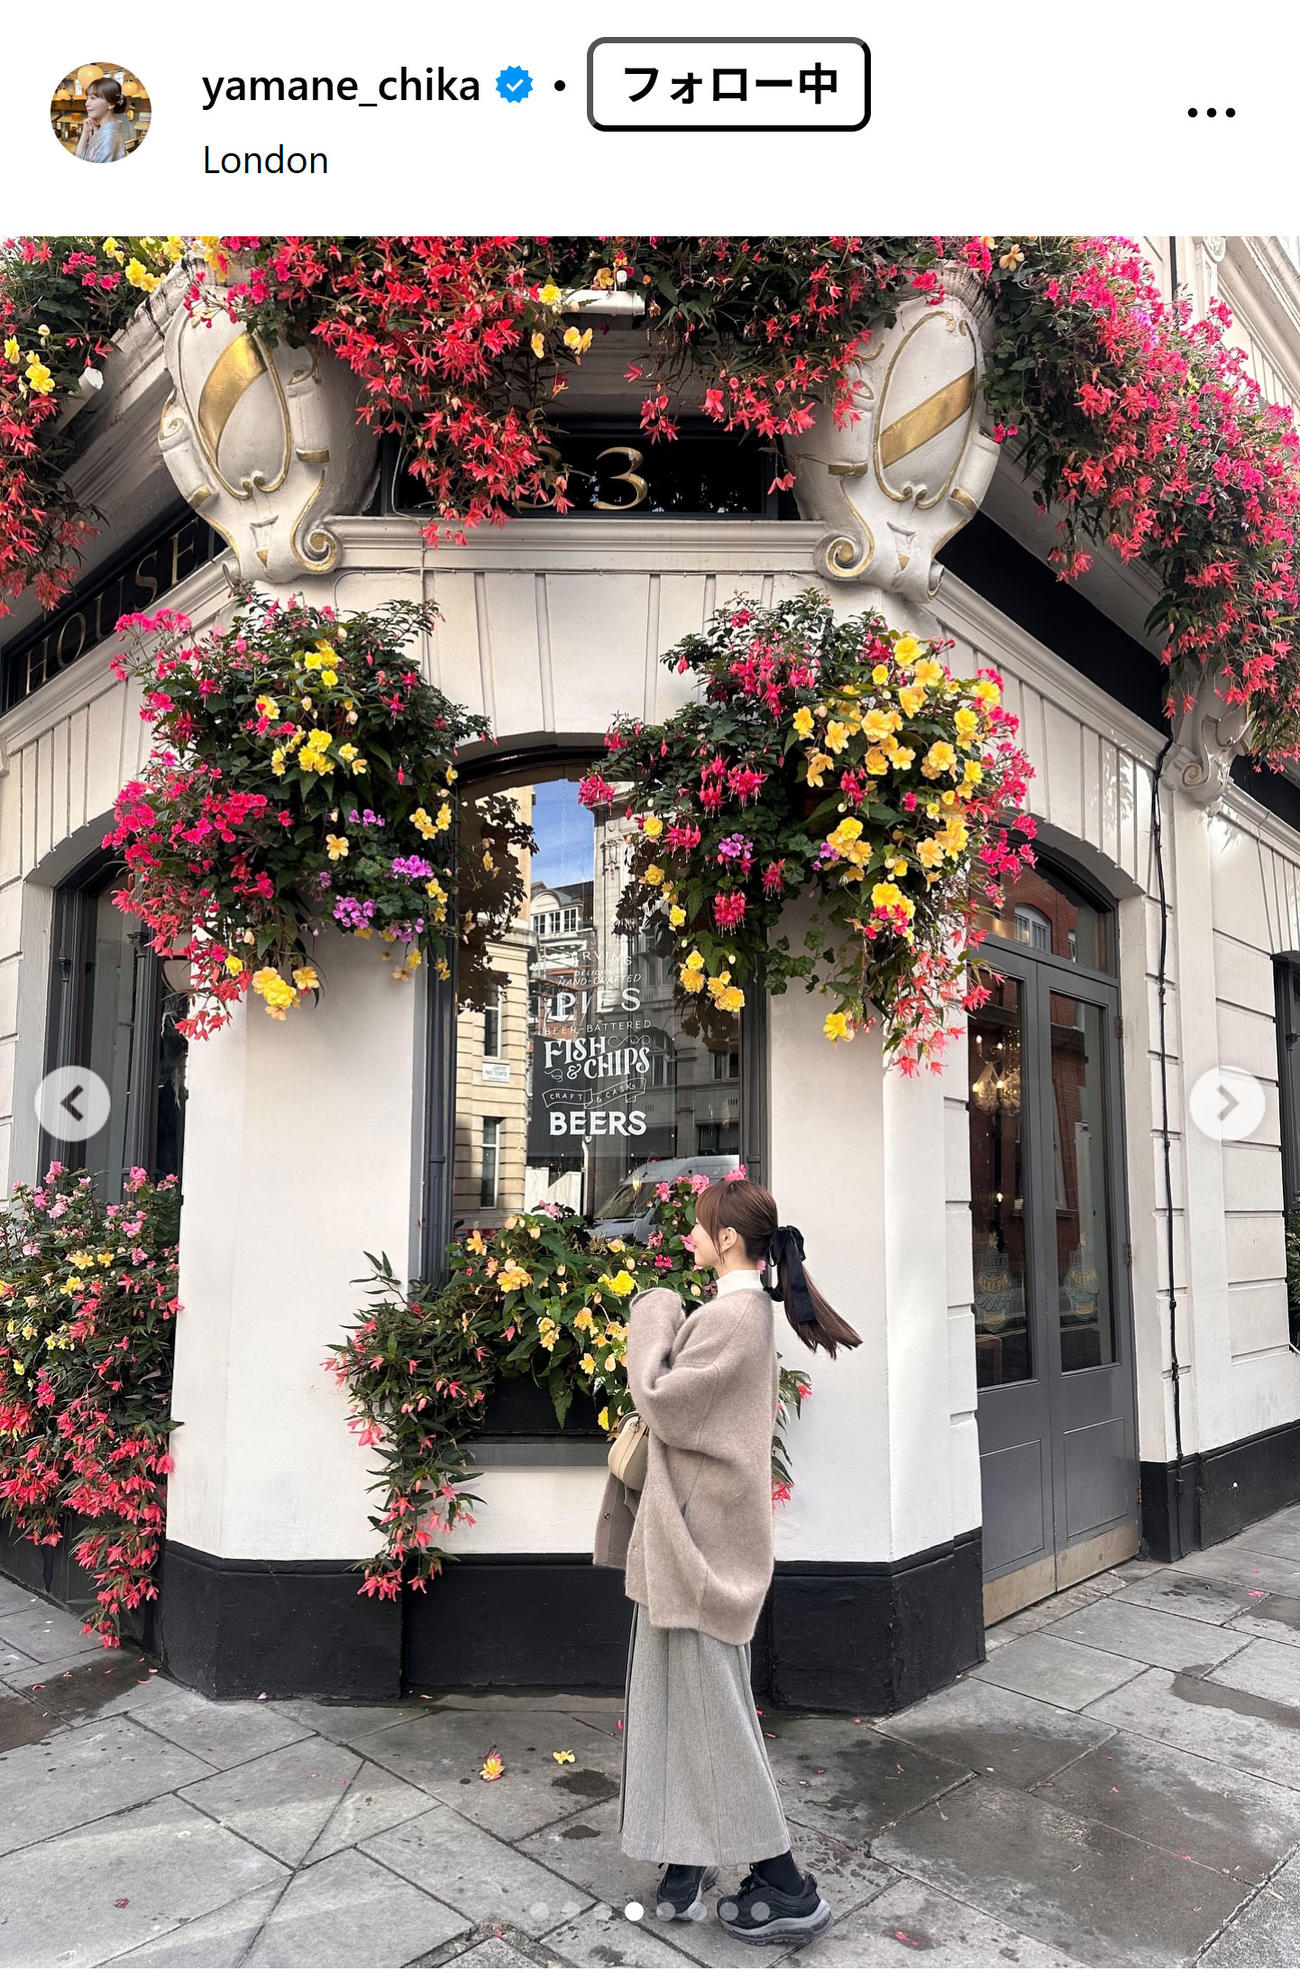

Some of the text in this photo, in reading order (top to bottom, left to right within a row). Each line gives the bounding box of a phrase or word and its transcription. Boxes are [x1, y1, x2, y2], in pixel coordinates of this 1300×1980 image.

[26, 516, 200, 697] HOUSE
[557, 973, 642, 987] HAND-CRAFTED
[556, 987, 641, 1014] PIES
[544, 1019, 652, 1036] BEER-BATTERED
[543, 1036, 606, 1069] FISH
[566, 1046, 651, 1080] & CHIPS
[549, 1092, 583, 1101] CRAFT
[605, 1083, 636, 1099] CASK
[549, 1110, 647, 1136] BEERS
